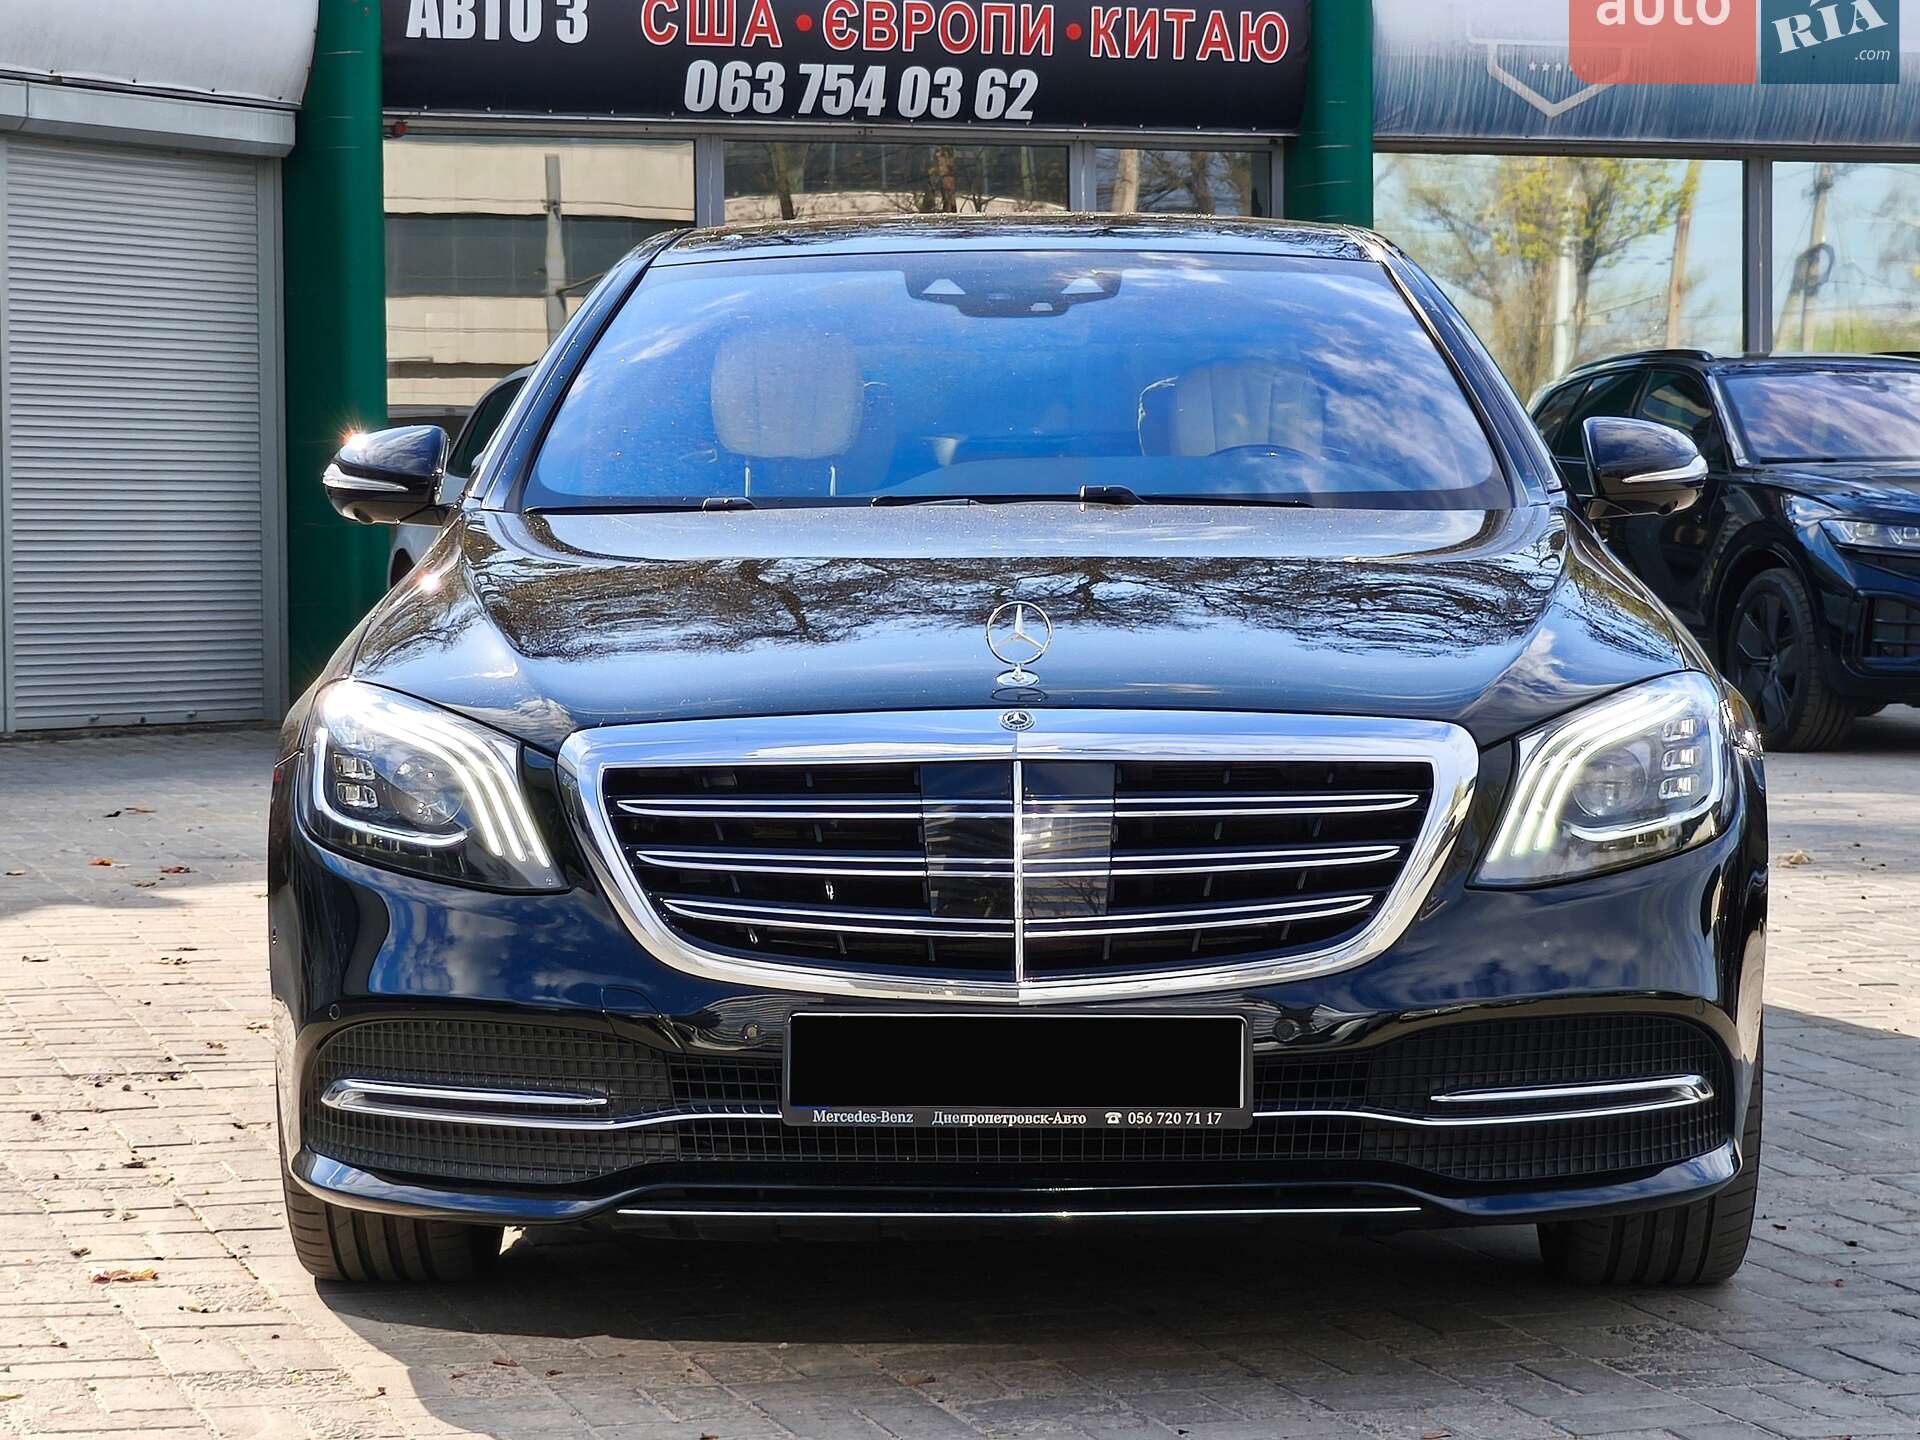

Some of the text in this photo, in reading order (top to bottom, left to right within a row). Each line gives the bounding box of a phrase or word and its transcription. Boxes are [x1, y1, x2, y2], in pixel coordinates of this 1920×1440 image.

[640, 0, 784, 49] США
[821, 0, 1054, 57] ЄВРОПИ
[1089, 5, 1290, 64] КИТАЮ
[683, 59, 1040, 121] 063 754 03 62
[812, 1109, 1223, 1127] Mercedes-Benz Днепропетровск-Авто 056 720 71 17
